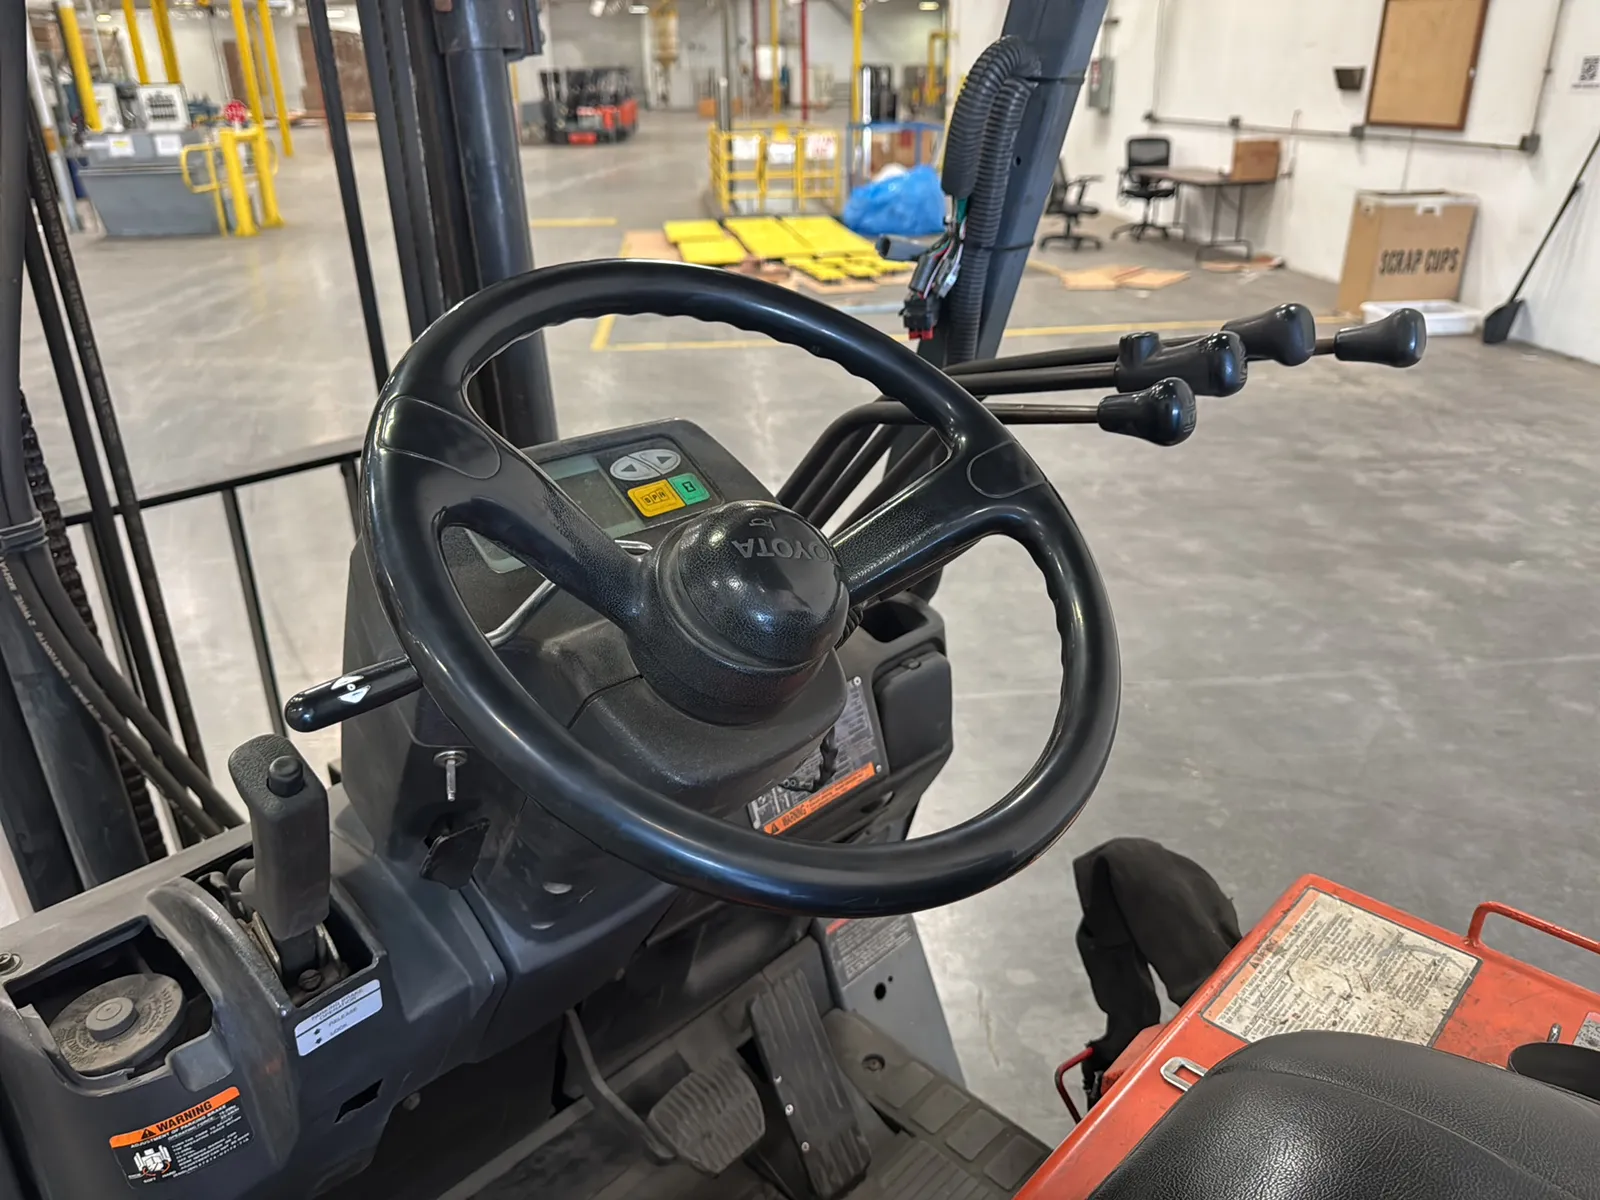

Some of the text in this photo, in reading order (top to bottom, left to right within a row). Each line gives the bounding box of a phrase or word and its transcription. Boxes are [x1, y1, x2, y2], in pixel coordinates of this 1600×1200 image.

[1379, 246, 1460, 275] SCRAP CUPS
[156, 1101, 213, 1132] WARNING
[130, 1132, 170, 1149] ADJUSTMENT
